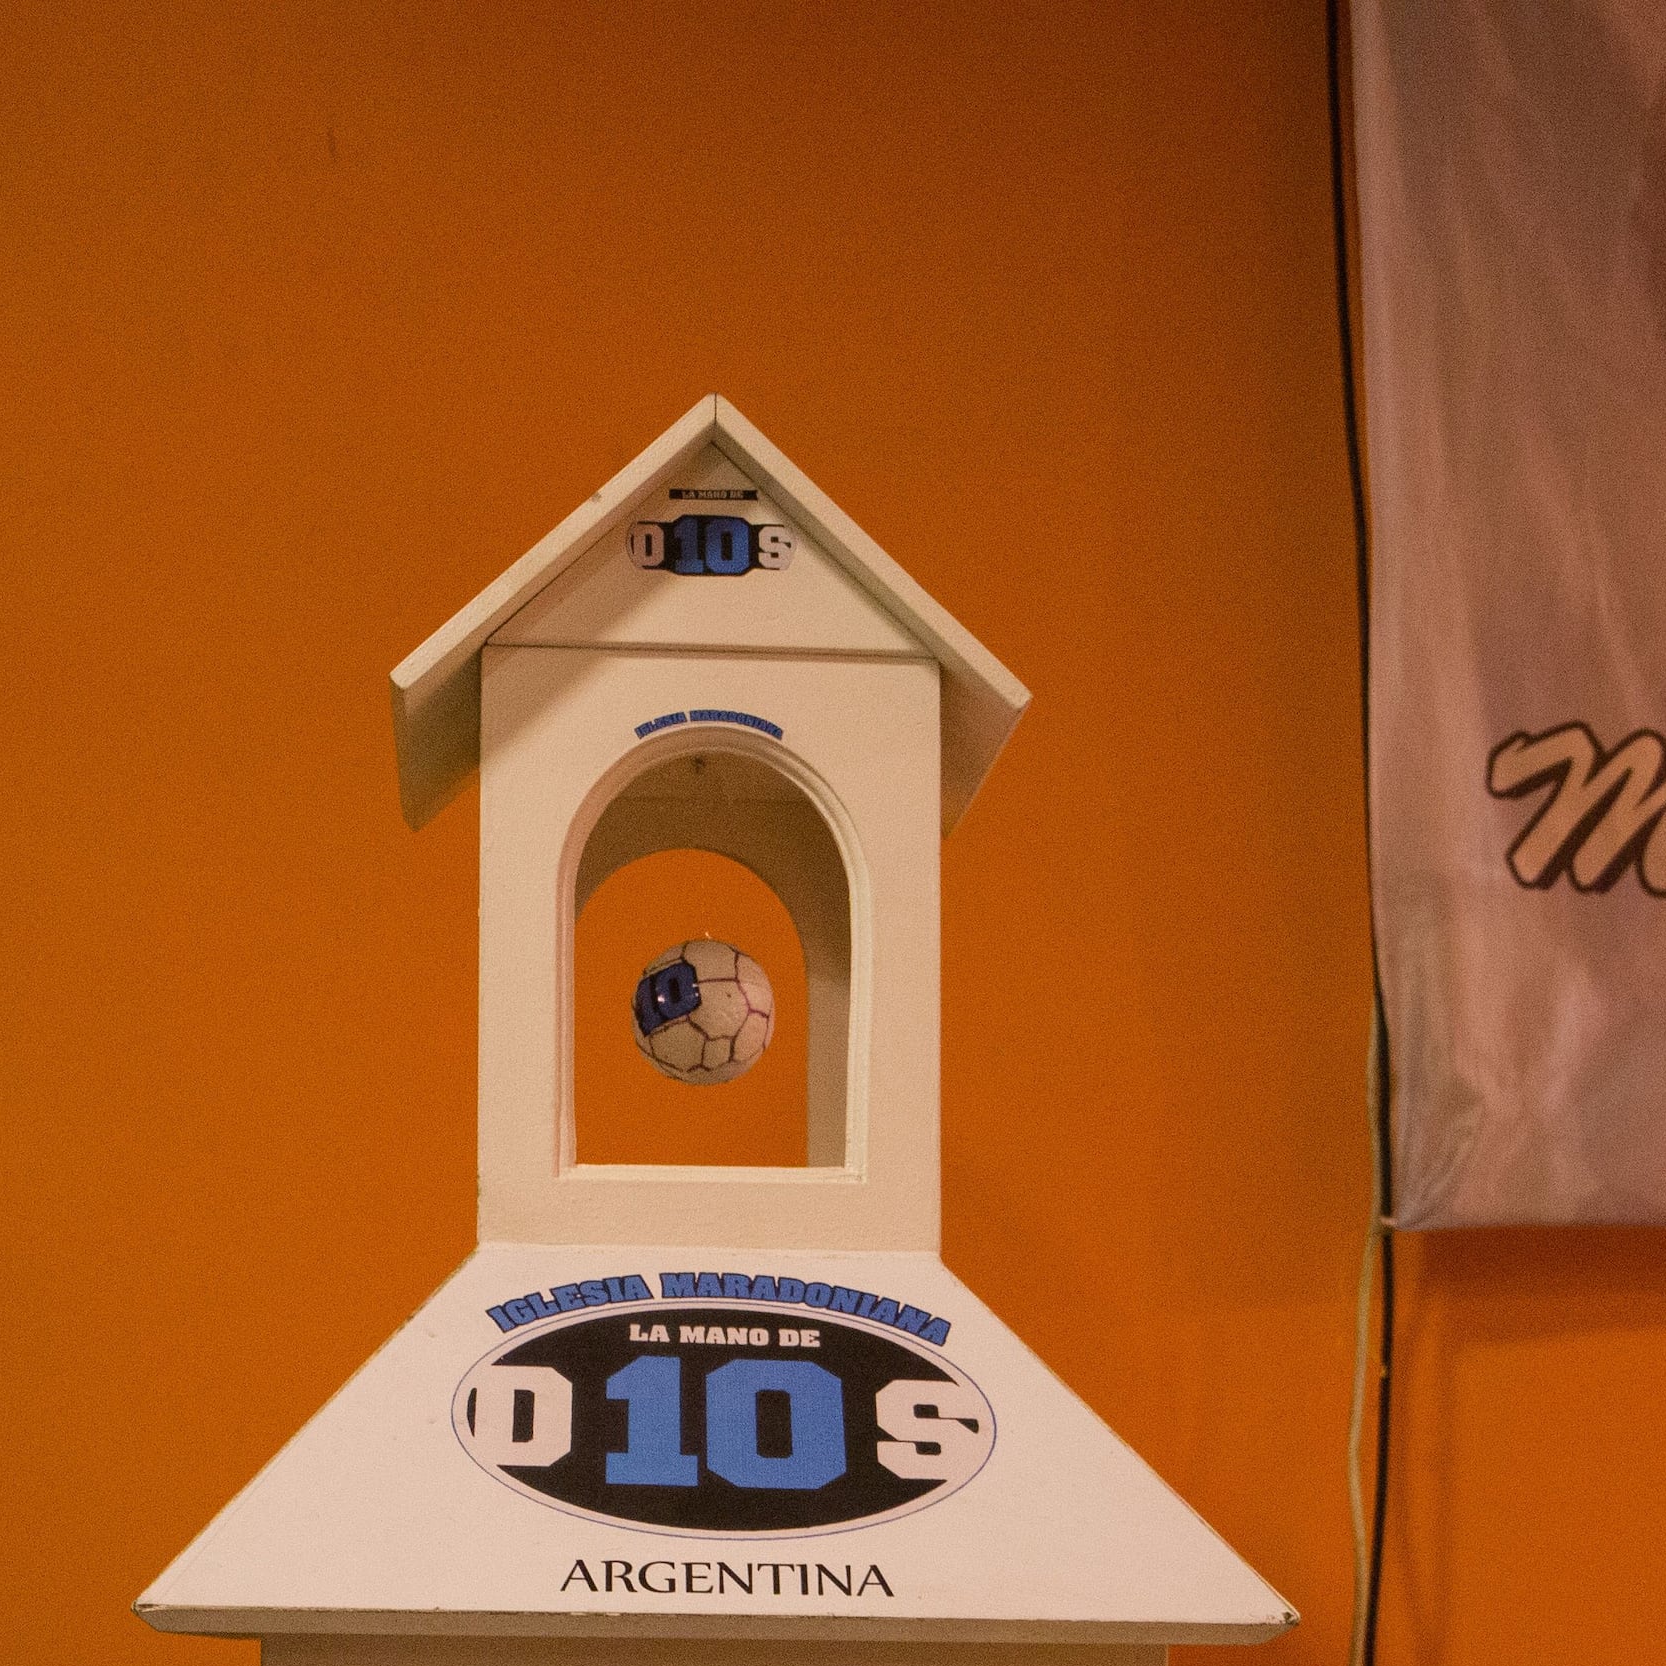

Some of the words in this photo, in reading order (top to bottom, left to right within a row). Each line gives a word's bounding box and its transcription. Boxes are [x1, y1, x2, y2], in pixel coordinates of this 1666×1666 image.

[486, 1273, 655, 1335] IGLESIA
[659, 1271, 954, 1348] MARADONIANA
[629, 1322, 671, 1343] LA
[678, 1325, 770, 1347] MANO
[778, 1326, 821, 1349] DE
[559, 1558, 896, 1599] ARGENTINA
